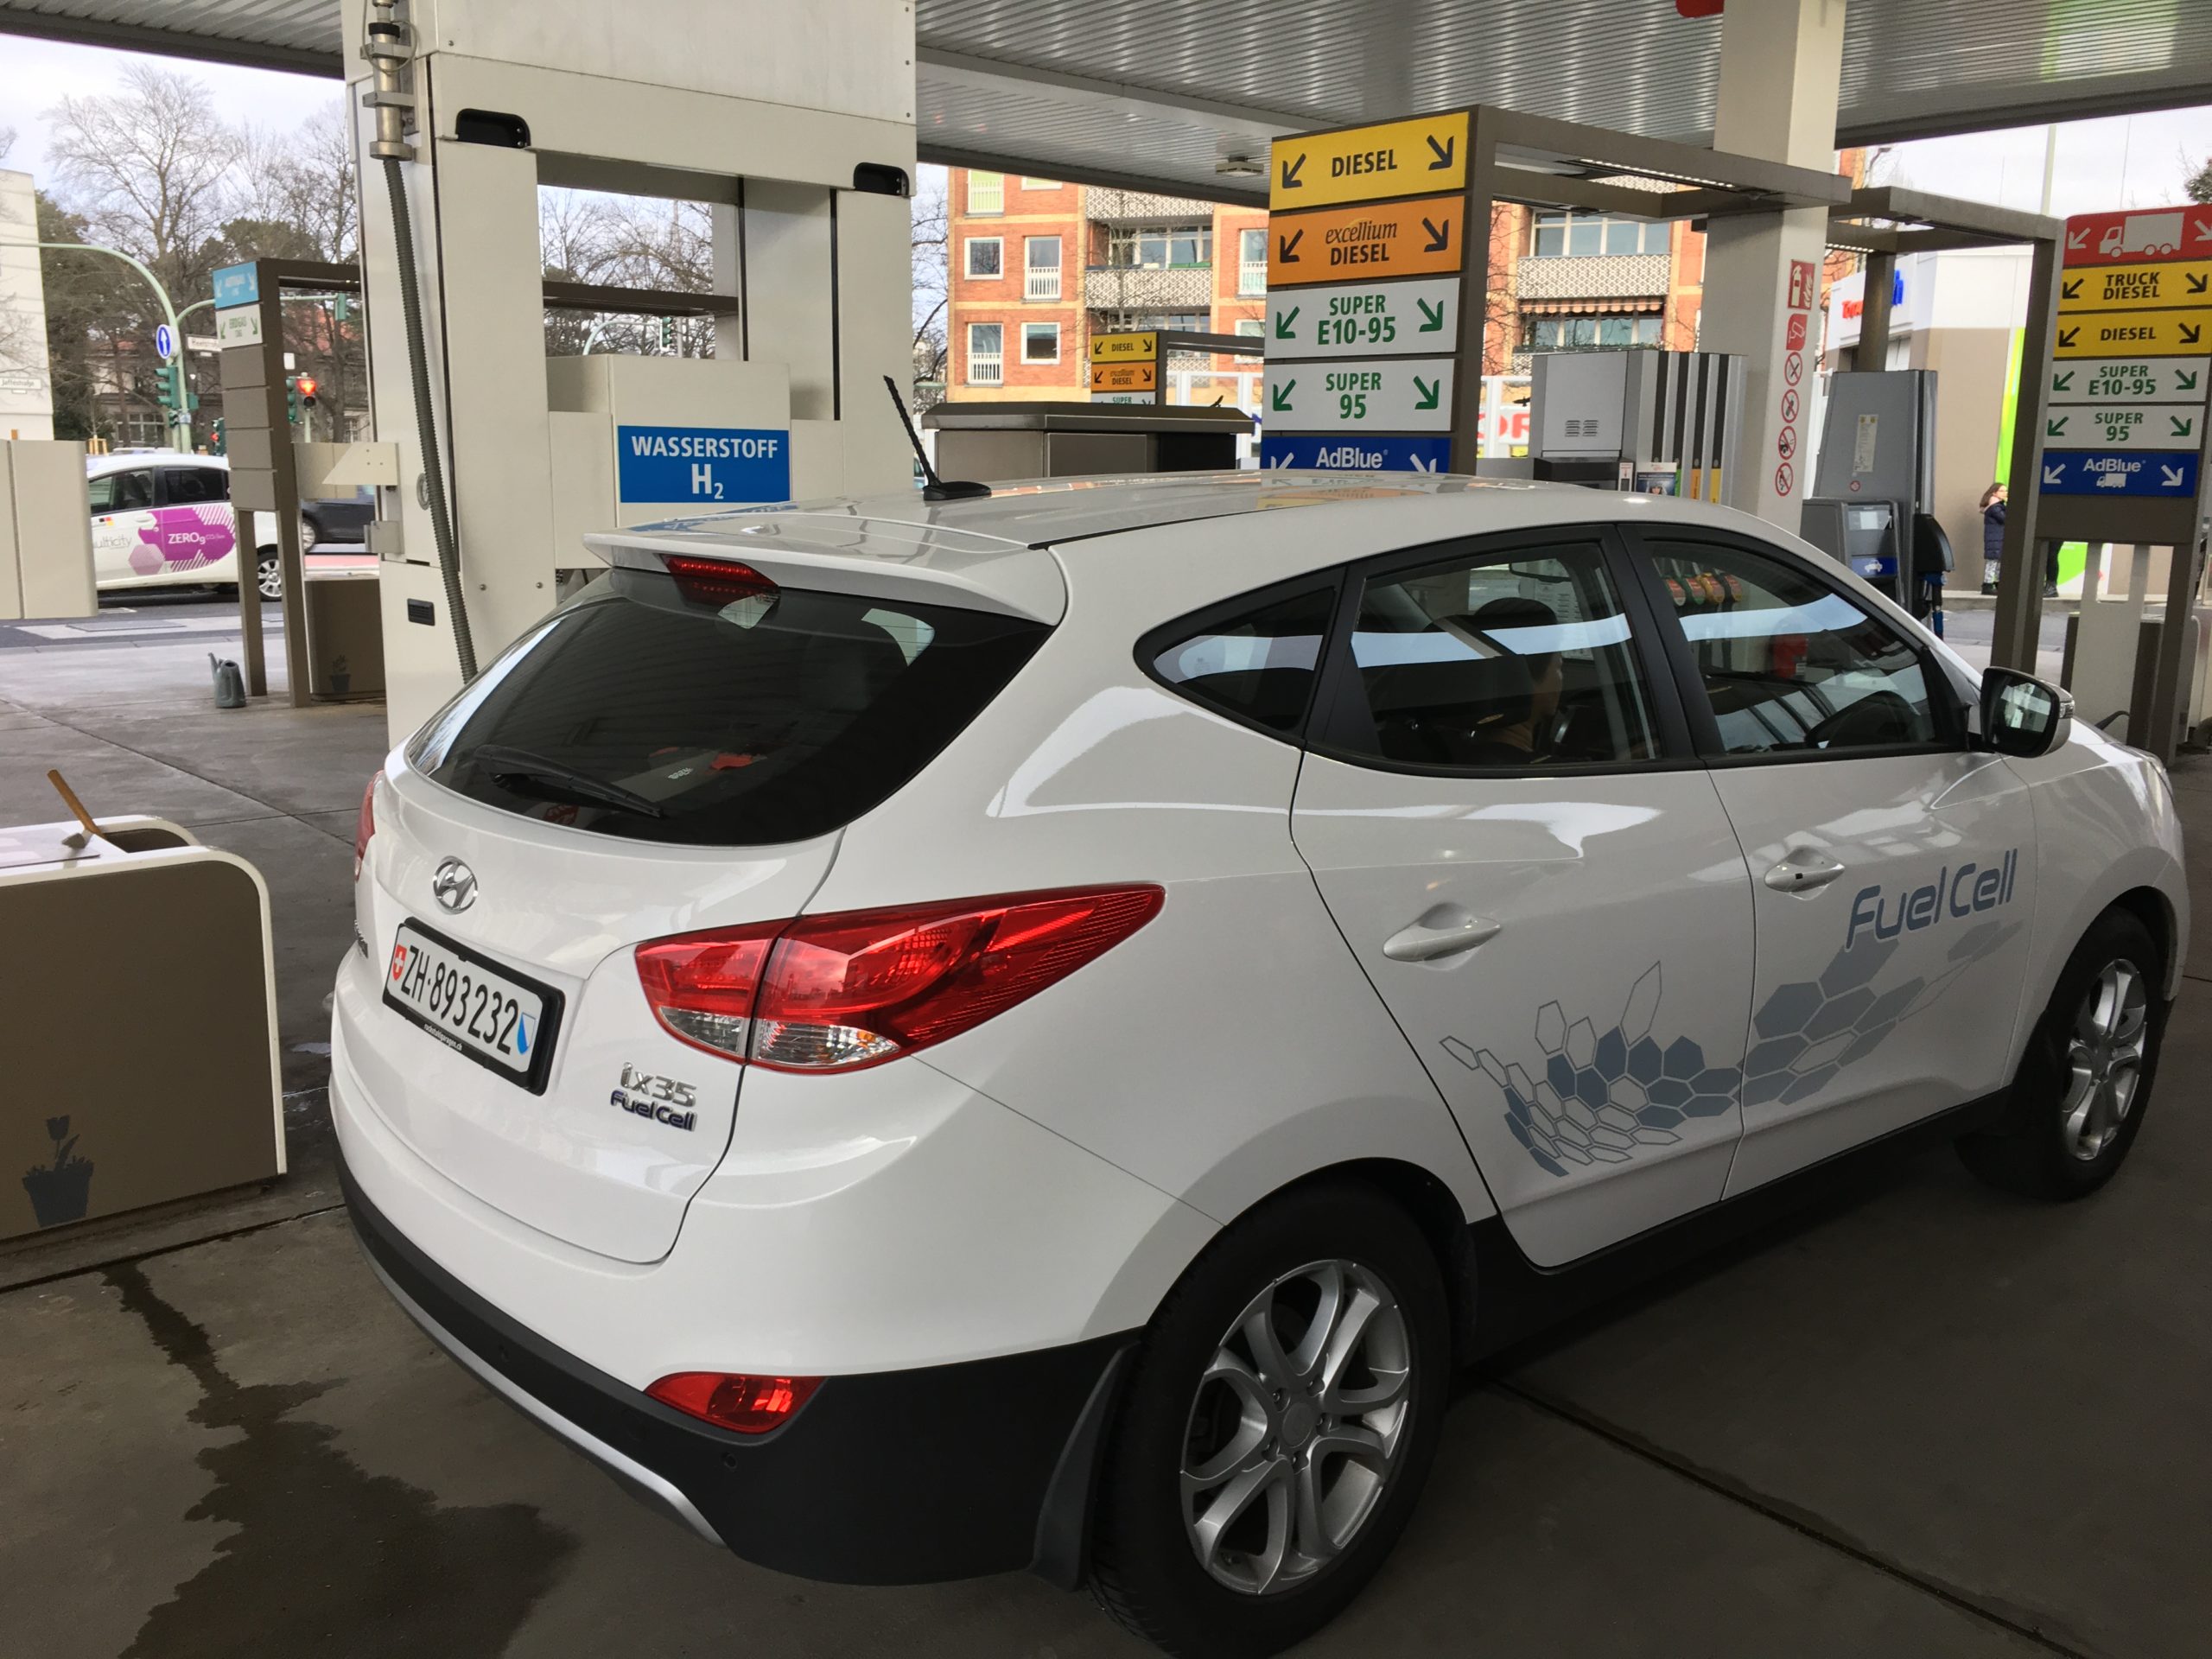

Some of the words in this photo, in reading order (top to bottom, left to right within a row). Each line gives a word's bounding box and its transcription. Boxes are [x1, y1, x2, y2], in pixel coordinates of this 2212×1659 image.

[1332, 149, 1397, 178] DIESEL
[1325, 220, 1397, 245] excellium
[1331, 243, 1389, 266] DIESEL
[2106, 271, 2160, 287] TRUCK
[2103, 285, 2160, 301] DIESEL
[1329, 295, 1386, 316] SUPER
[1318, 316, 1396, 346] E10-95
[2101, 327, 2157, 341] DIESEL
[1111, 342, 1135, 353] DIESEL
[2100, 365, 2149, 378] SUPER
[1111, 377, 1134, 385] DIESEL
[1325, 372, 1382, 391] SUPER
[2088, 378, 2157, 396] E10-95
[1340, 394, 1367, 419] 95
[2094, 412, 2144, 425] SUPER
[2106, 425, 2130, 442] 95
[632, 435, 778, 459] WASSERSTOFF
[620, 1062, 696, 1107] ix35
